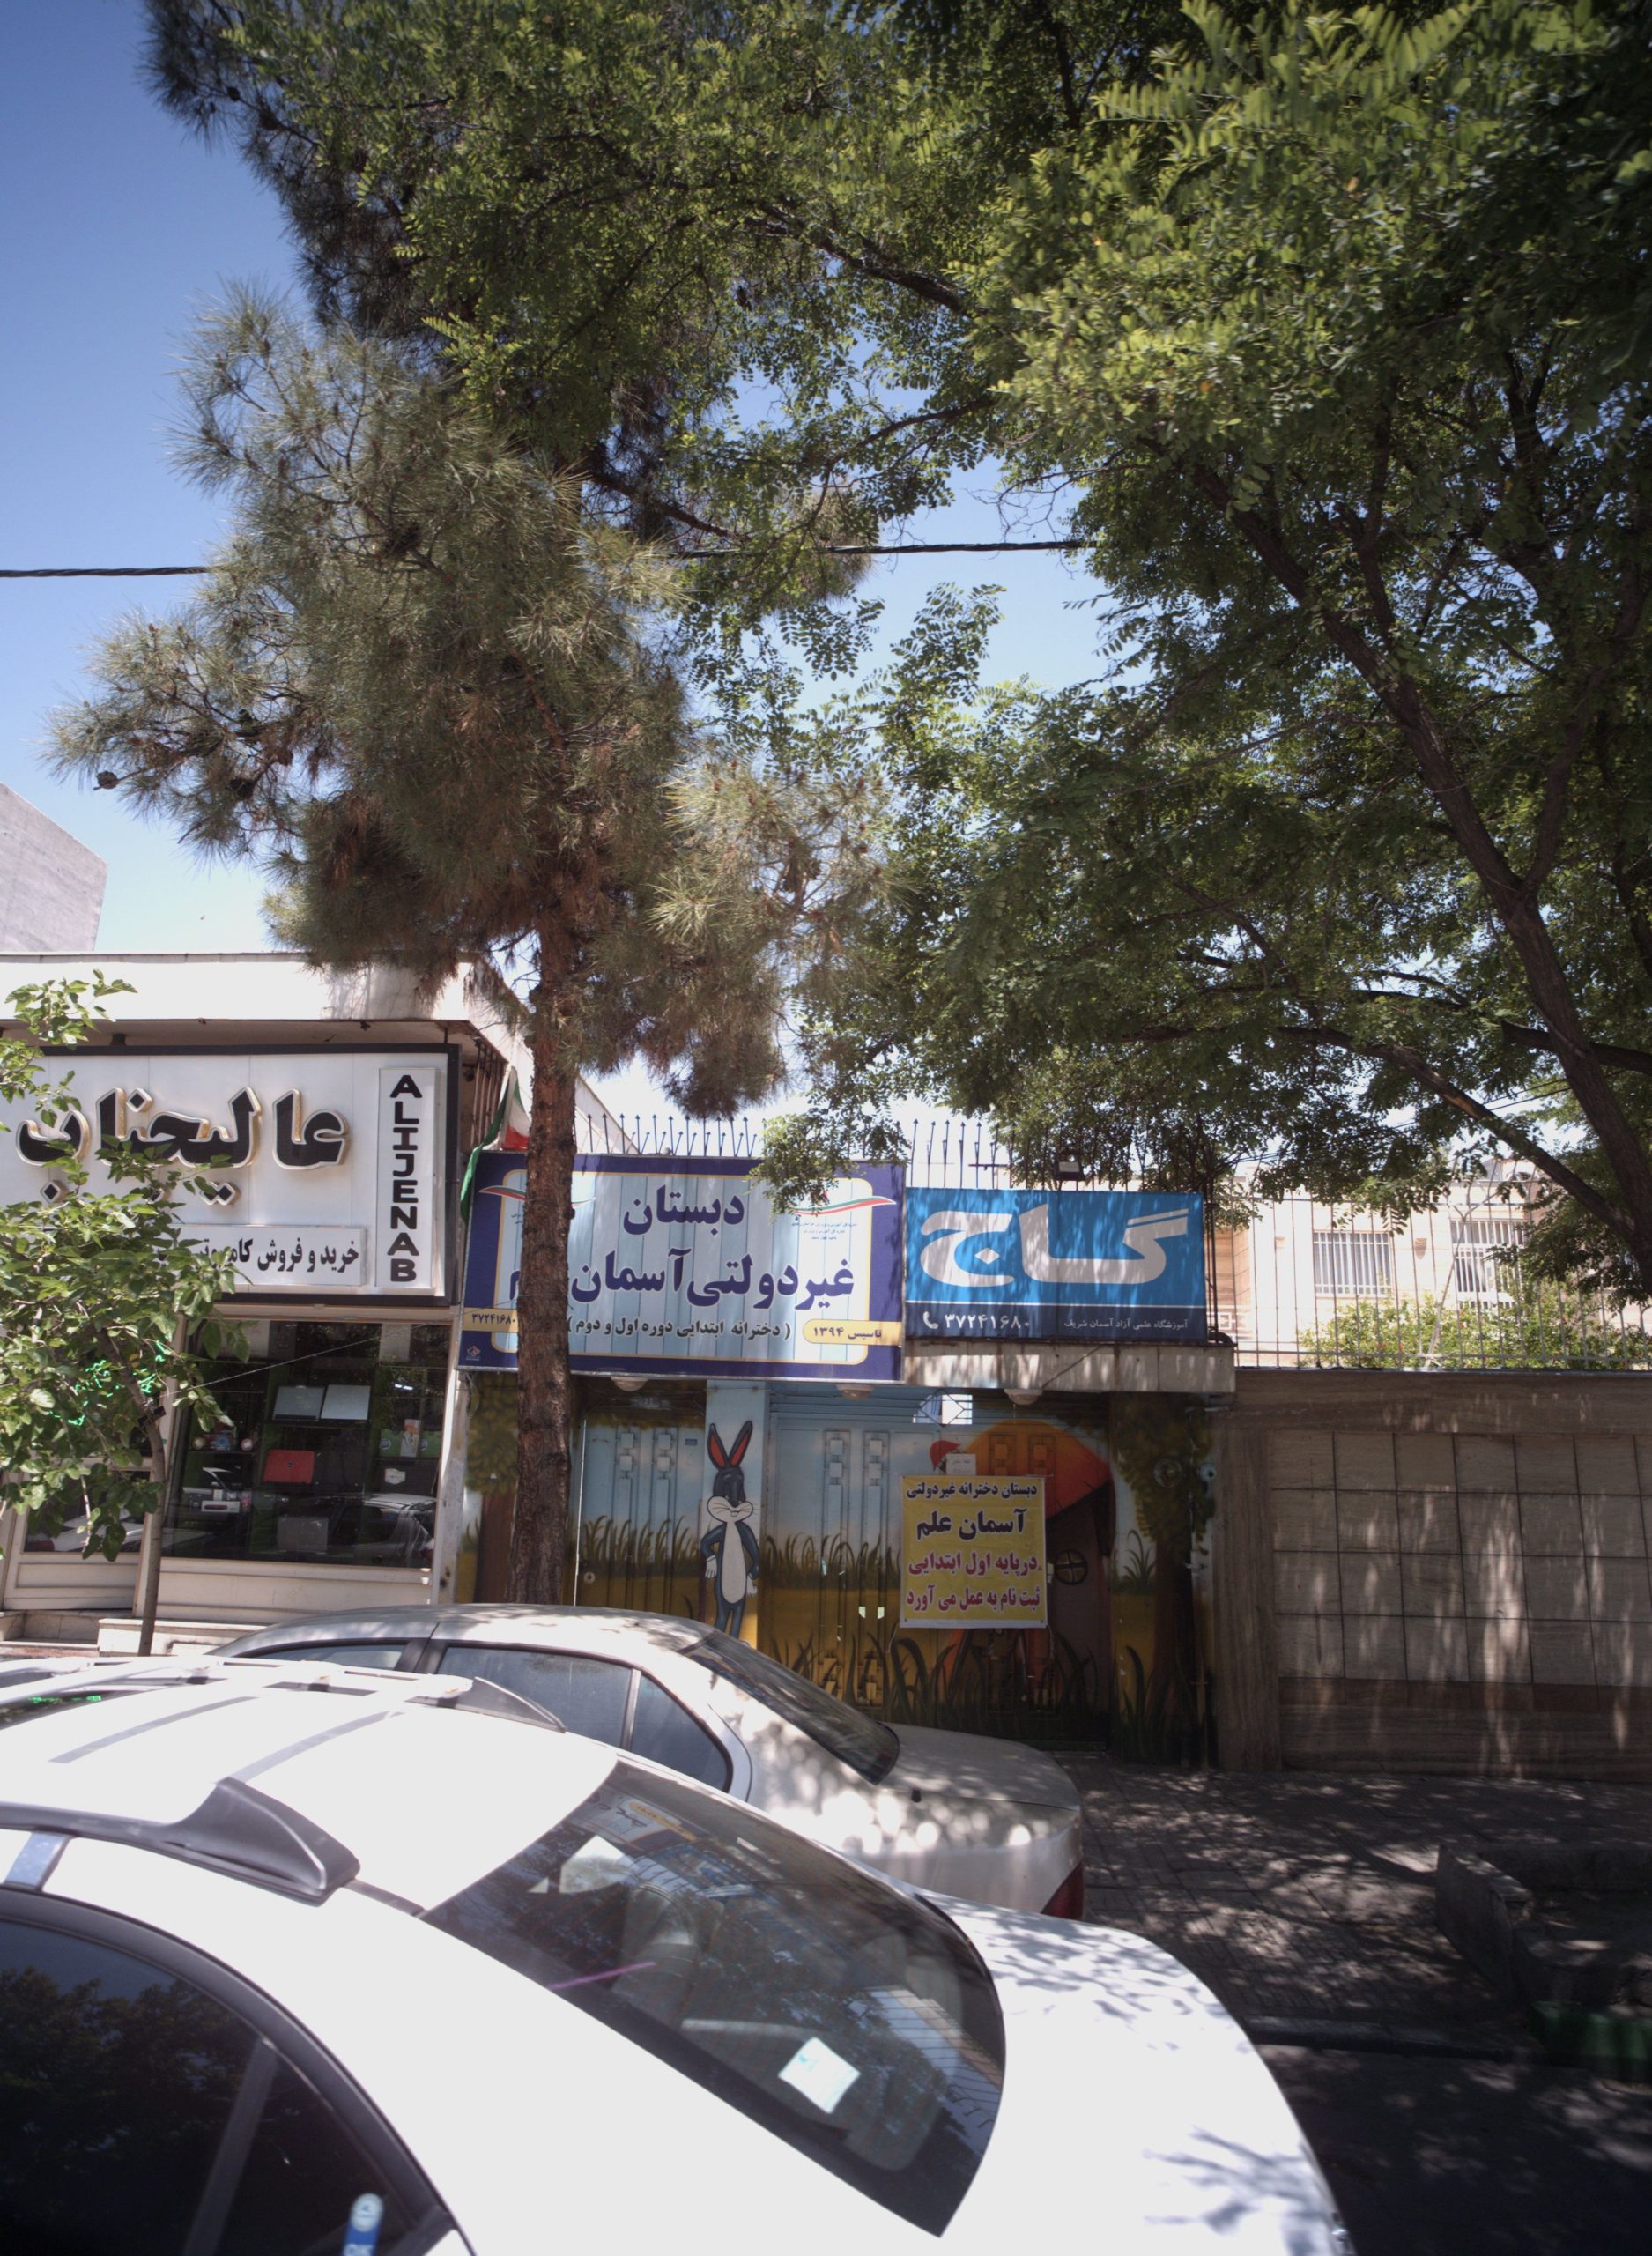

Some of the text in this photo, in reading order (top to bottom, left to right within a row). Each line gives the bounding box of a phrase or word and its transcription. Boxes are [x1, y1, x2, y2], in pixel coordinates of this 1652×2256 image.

[388, 1074, 423, 1283] ALIJENAB
[622, 1185, 745, 1236] دبستان
[257, 1237, 303, 1272] فروش
[320, 1241, 359, 1273] خرید
[921, 1204, 1189, 1288] گاج
[307, 1248, 316, 1273] و
[571, 1248, 692, 1302] آسمان
[604, 1323, 611, 1335] و
[615, 1317, 638, 1335] اول
[641, 1321, 673, 1336] دوره
[677, 1321, 724, 1338] ابتدایی
[813, 1326, 844, 1337] ۱۳۹۴
[944, 1313, 1030, 1330] ۳۷۲۴۱۶۸۰
[959, 1482, 998, 1499] دخترانه
[1001, 1482, 1037, 1499] دبستان
[917, 1508, 1027, 1540] آسمان علم
[908, 1551, 961, 1576] ابتدایی
[966, 1551, 991, 1576] اول
[907, 1584, 1041, 1611] ثبت نام به عمل می آورد
